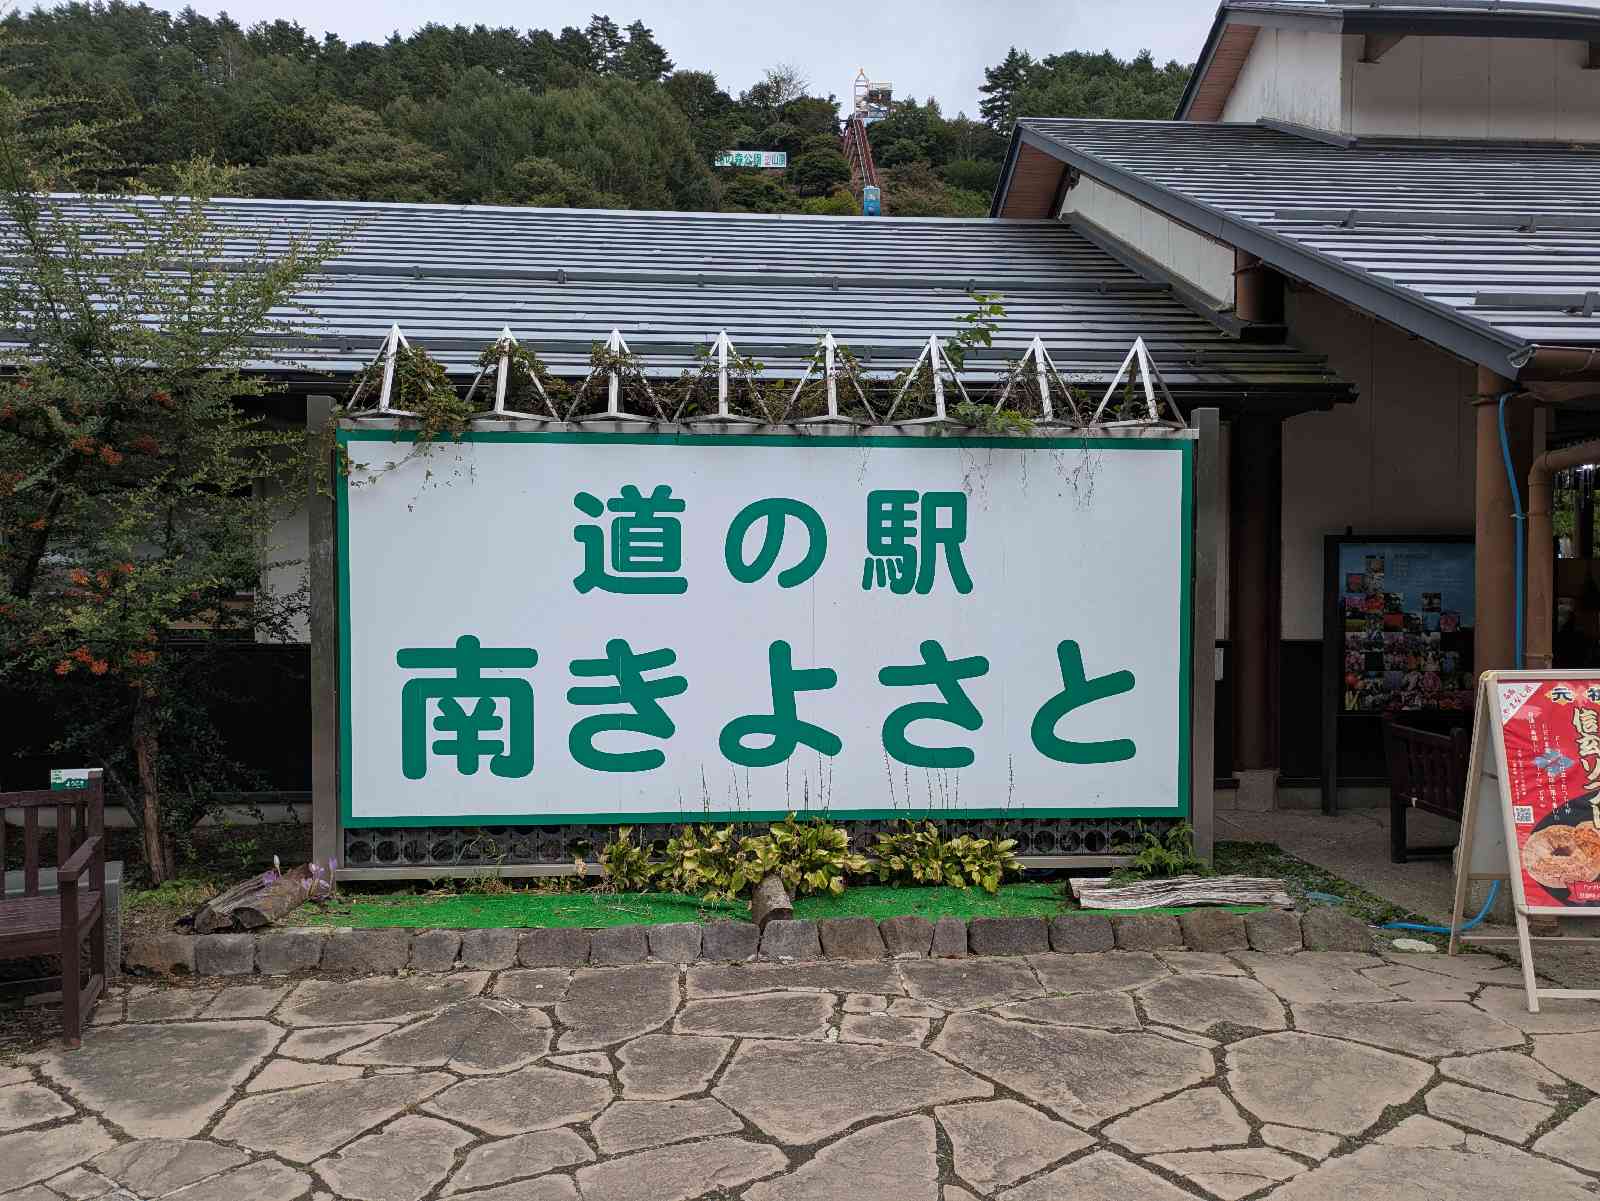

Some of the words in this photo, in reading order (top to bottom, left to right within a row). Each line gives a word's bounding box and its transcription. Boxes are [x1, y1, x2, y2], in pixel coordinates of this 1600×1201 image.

[573, 485, 973, 594] 道の駅
[397, 635, 1136, 780] 南きよさと
